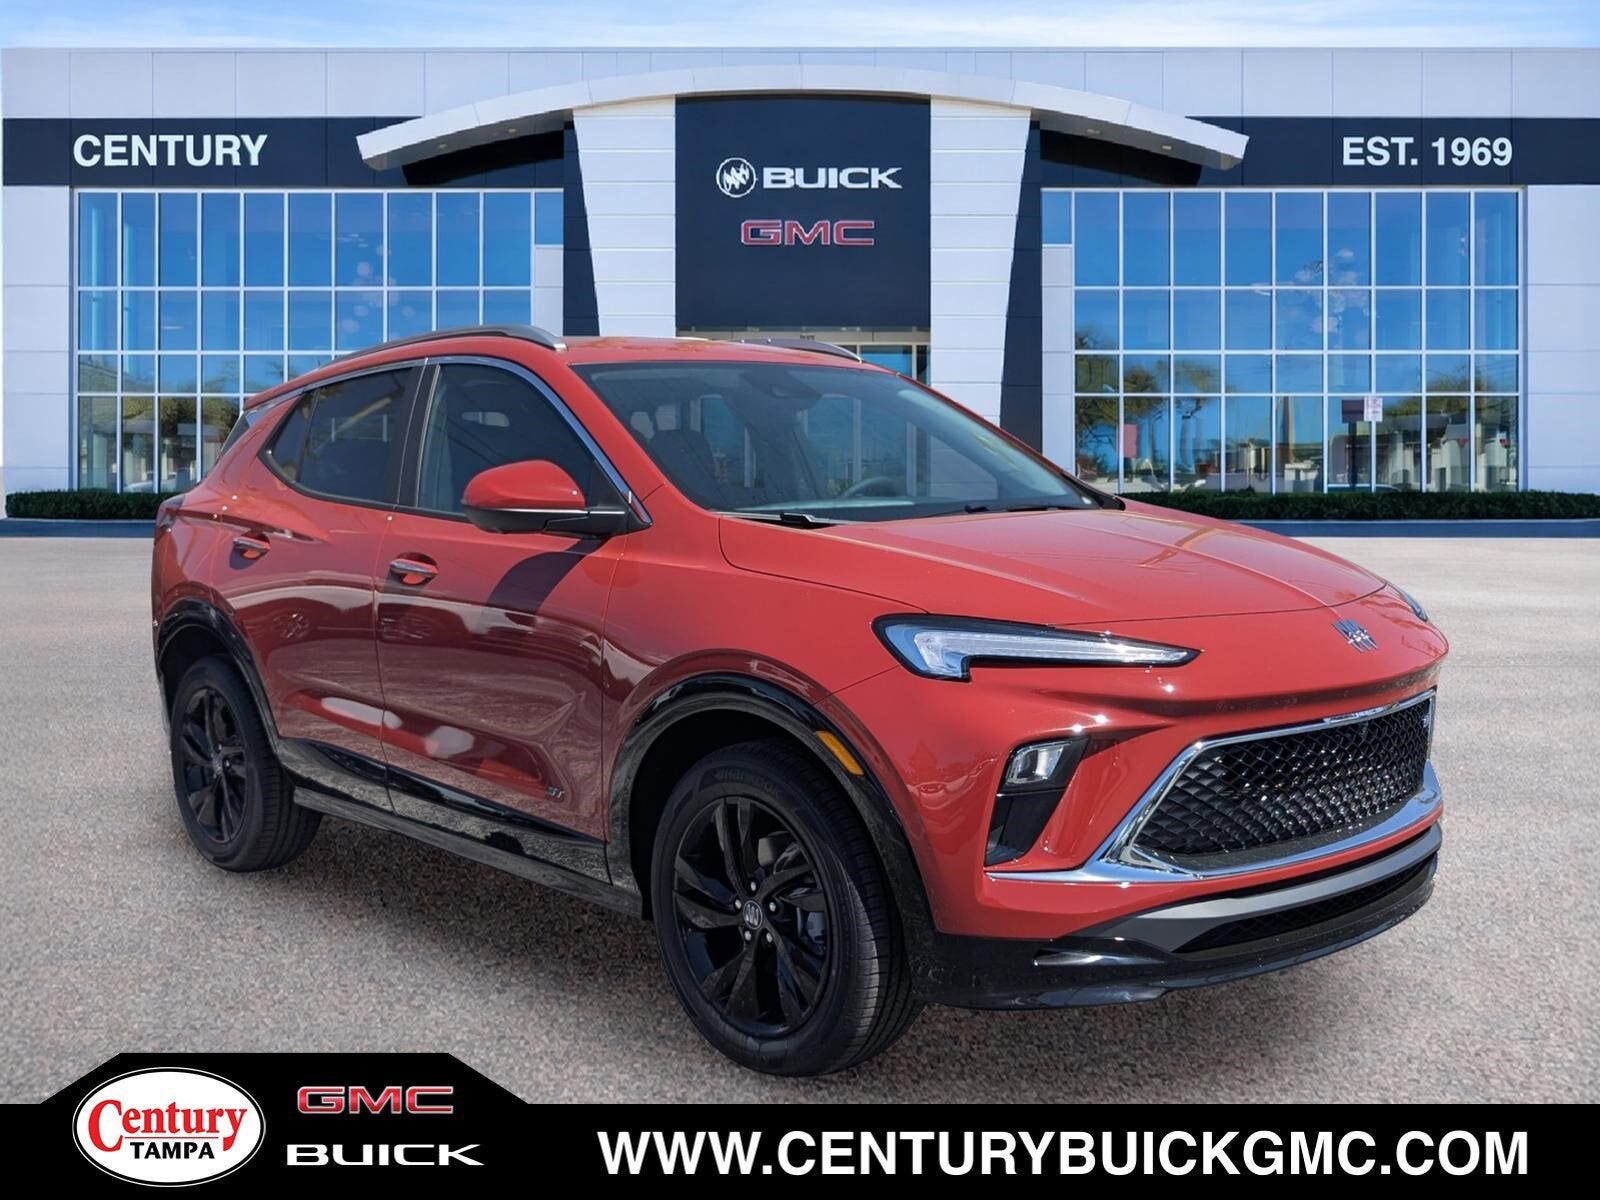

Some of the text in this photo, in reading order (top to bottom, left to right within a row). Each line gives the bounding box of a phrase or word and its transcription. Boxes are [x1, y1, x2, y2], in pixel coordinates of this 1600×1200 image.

[73, 134, 268, 167] CENTURY
[1342, 136, 1513, 167] EST. 1969
[763, 167, 902, 189] BUICK
[740, 219, 875, 246] GMC
